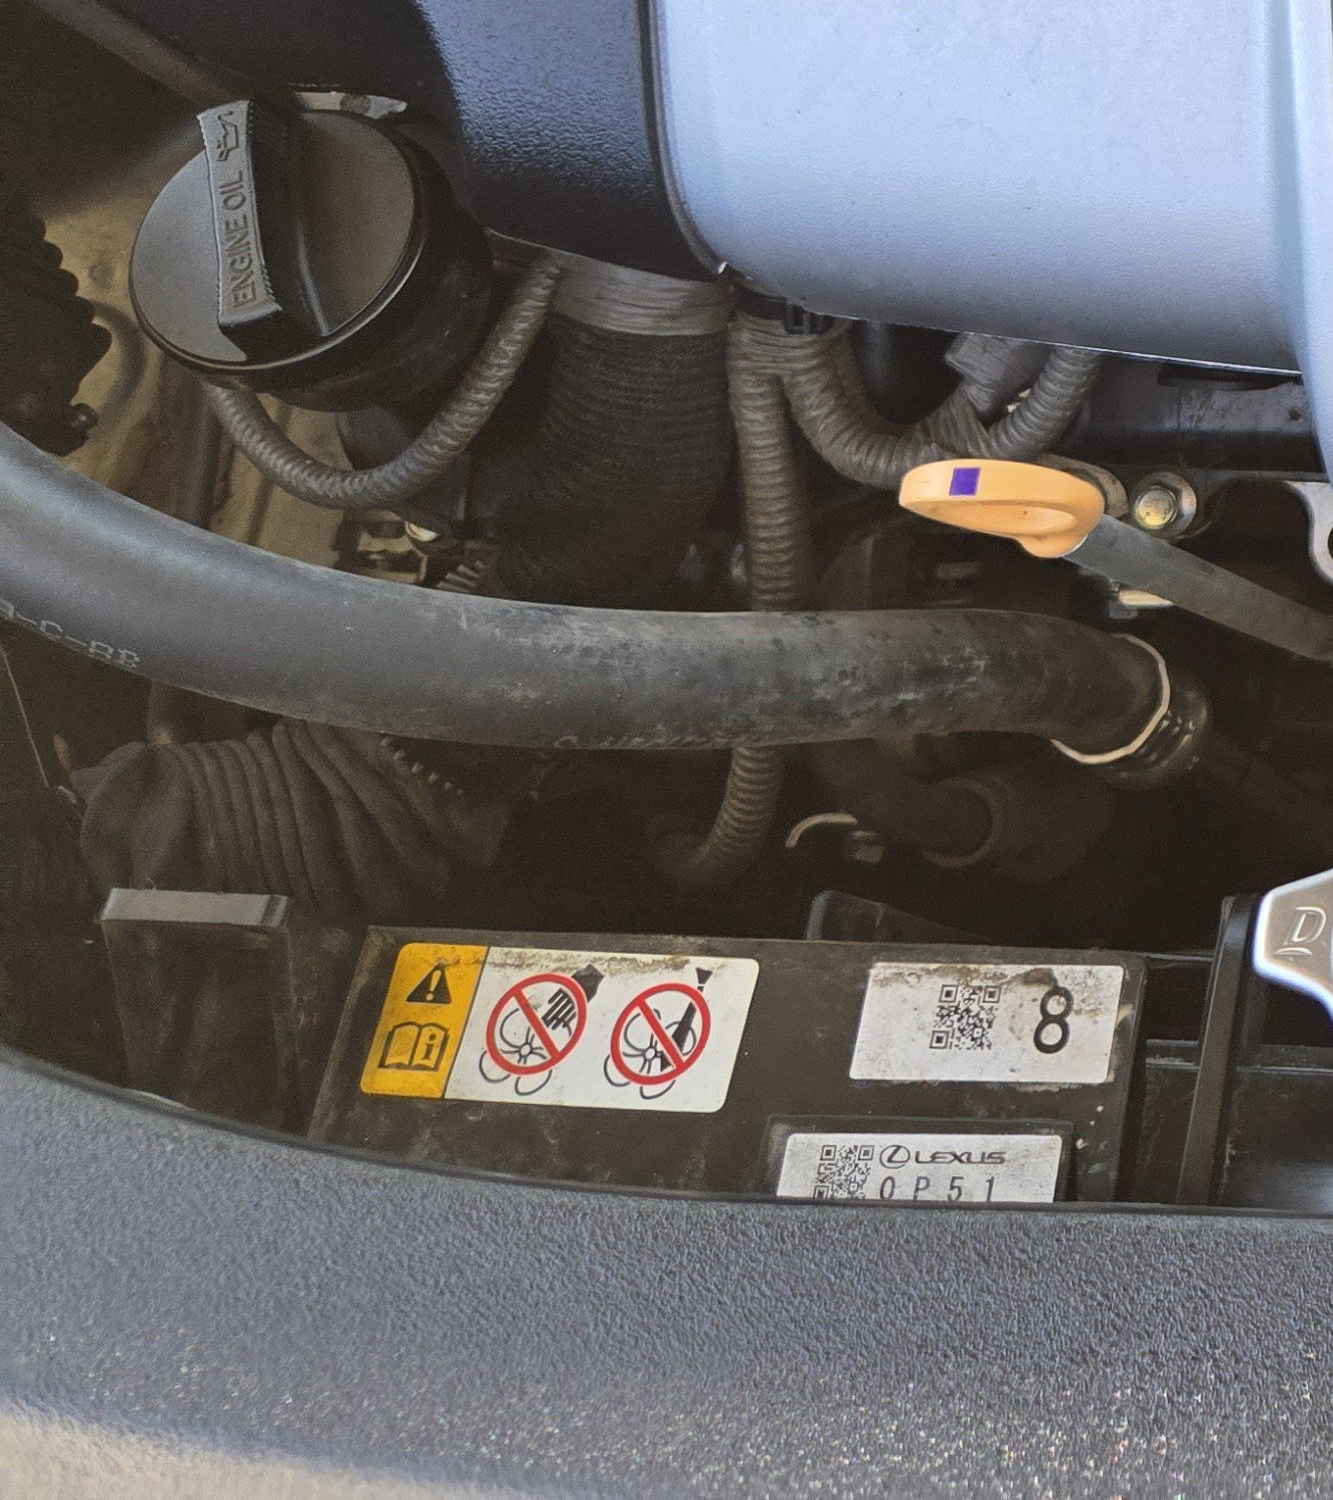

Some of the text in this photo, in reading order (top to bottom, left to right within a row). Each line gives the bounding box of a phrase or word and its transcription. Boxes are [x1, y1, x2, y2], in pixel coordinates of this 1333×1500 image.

[219, 170, 257, 308] ENGINE OIL
[1033, 984, 1074, 1054] 8
[915, 1150, 1007, 1166] LEXUS
